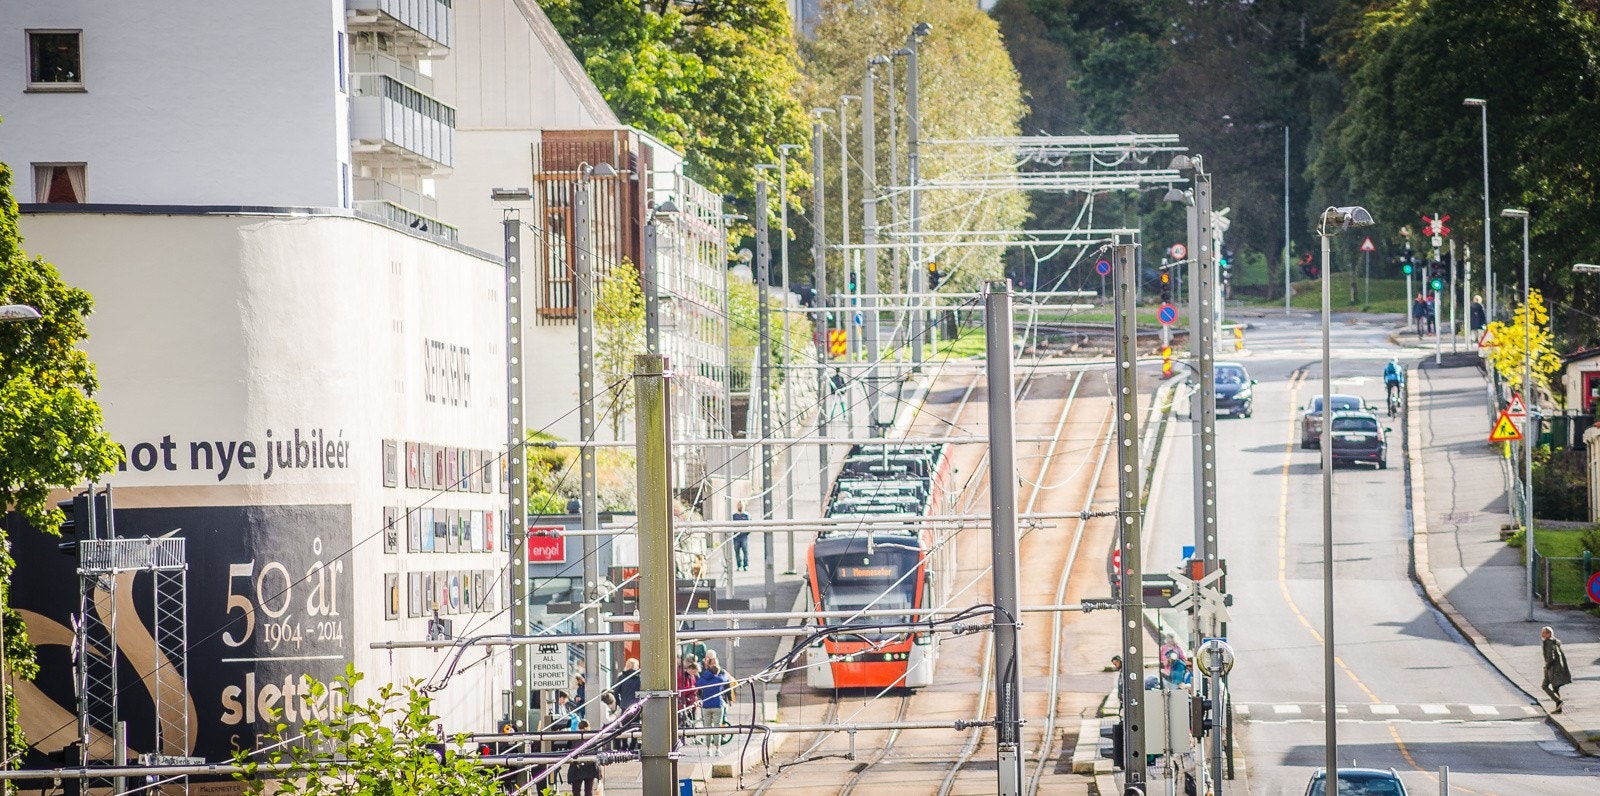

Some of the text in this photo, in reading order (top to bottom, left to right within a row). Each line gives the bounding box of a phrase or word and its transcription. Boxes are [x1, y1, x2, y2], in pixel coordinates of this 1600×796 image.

[190, 440, 256, 481] nye
[263, 428, 349, 480] jubileér
[533, 542, 559, 559] engel
[223, 559, 291, 648] 50
[306, 537, 344, 617] år
[263, 614, 303, 651] 1964
[317, 621, 343, 647] 2014
[220, 672, 343, 725] sletten
